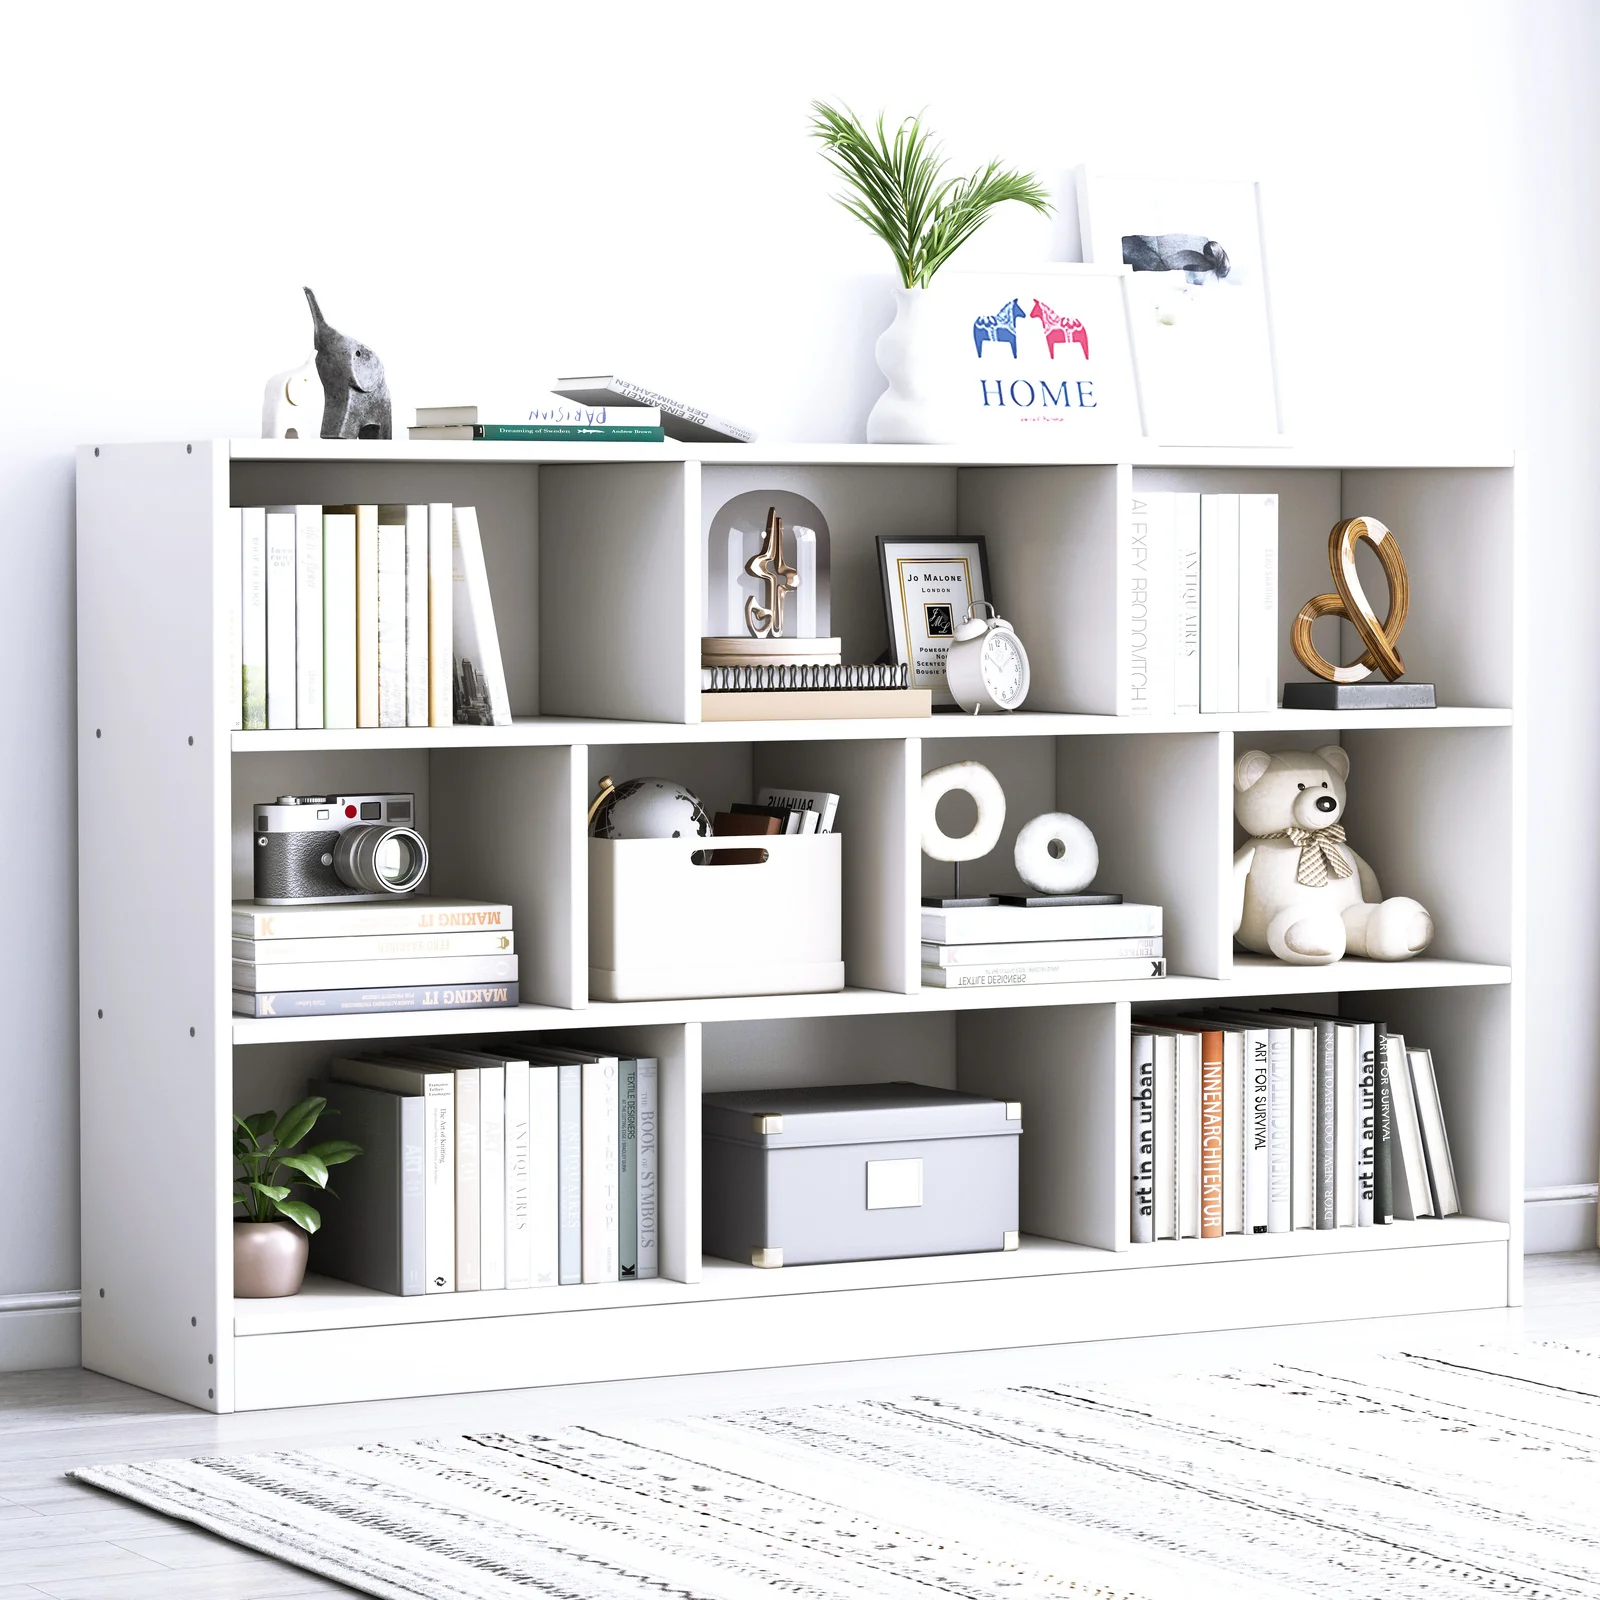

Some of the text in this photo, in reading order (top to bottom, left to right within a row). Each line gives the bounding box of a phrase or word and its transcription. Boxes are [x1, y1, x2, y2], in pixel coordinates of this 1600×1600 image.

[615, 378, 709, 418] DER PRIMZAHLEN
[620, 388, 706, 425] DIE EINSAMKEIT
[980, 380, 1098, 408] HOME
[528, 406, 607, 425] PARISIAN
[438, 911, 502, 927] MAKING
[422, 988, 507, 1005] MAKING IT
[627, 1072, 635, 1139] TEXTILE DESIGNERS
[641, 1092, 649, 1108] THE
[1254, 1041, 1267, 1150] ART FOR SURVIVAL
[1381, 1089, 1390, 1141] SURVIVAL
[641, 1111, 654, 1155] BOOK
[1133, 1062, 1153, 1217] art in an urban
[1358, 1050, 1374, 1200] art in an urban
[439, 1139, 447, 1163] Knitting
[641, 1171, 655, 1249] SYMBOLS
